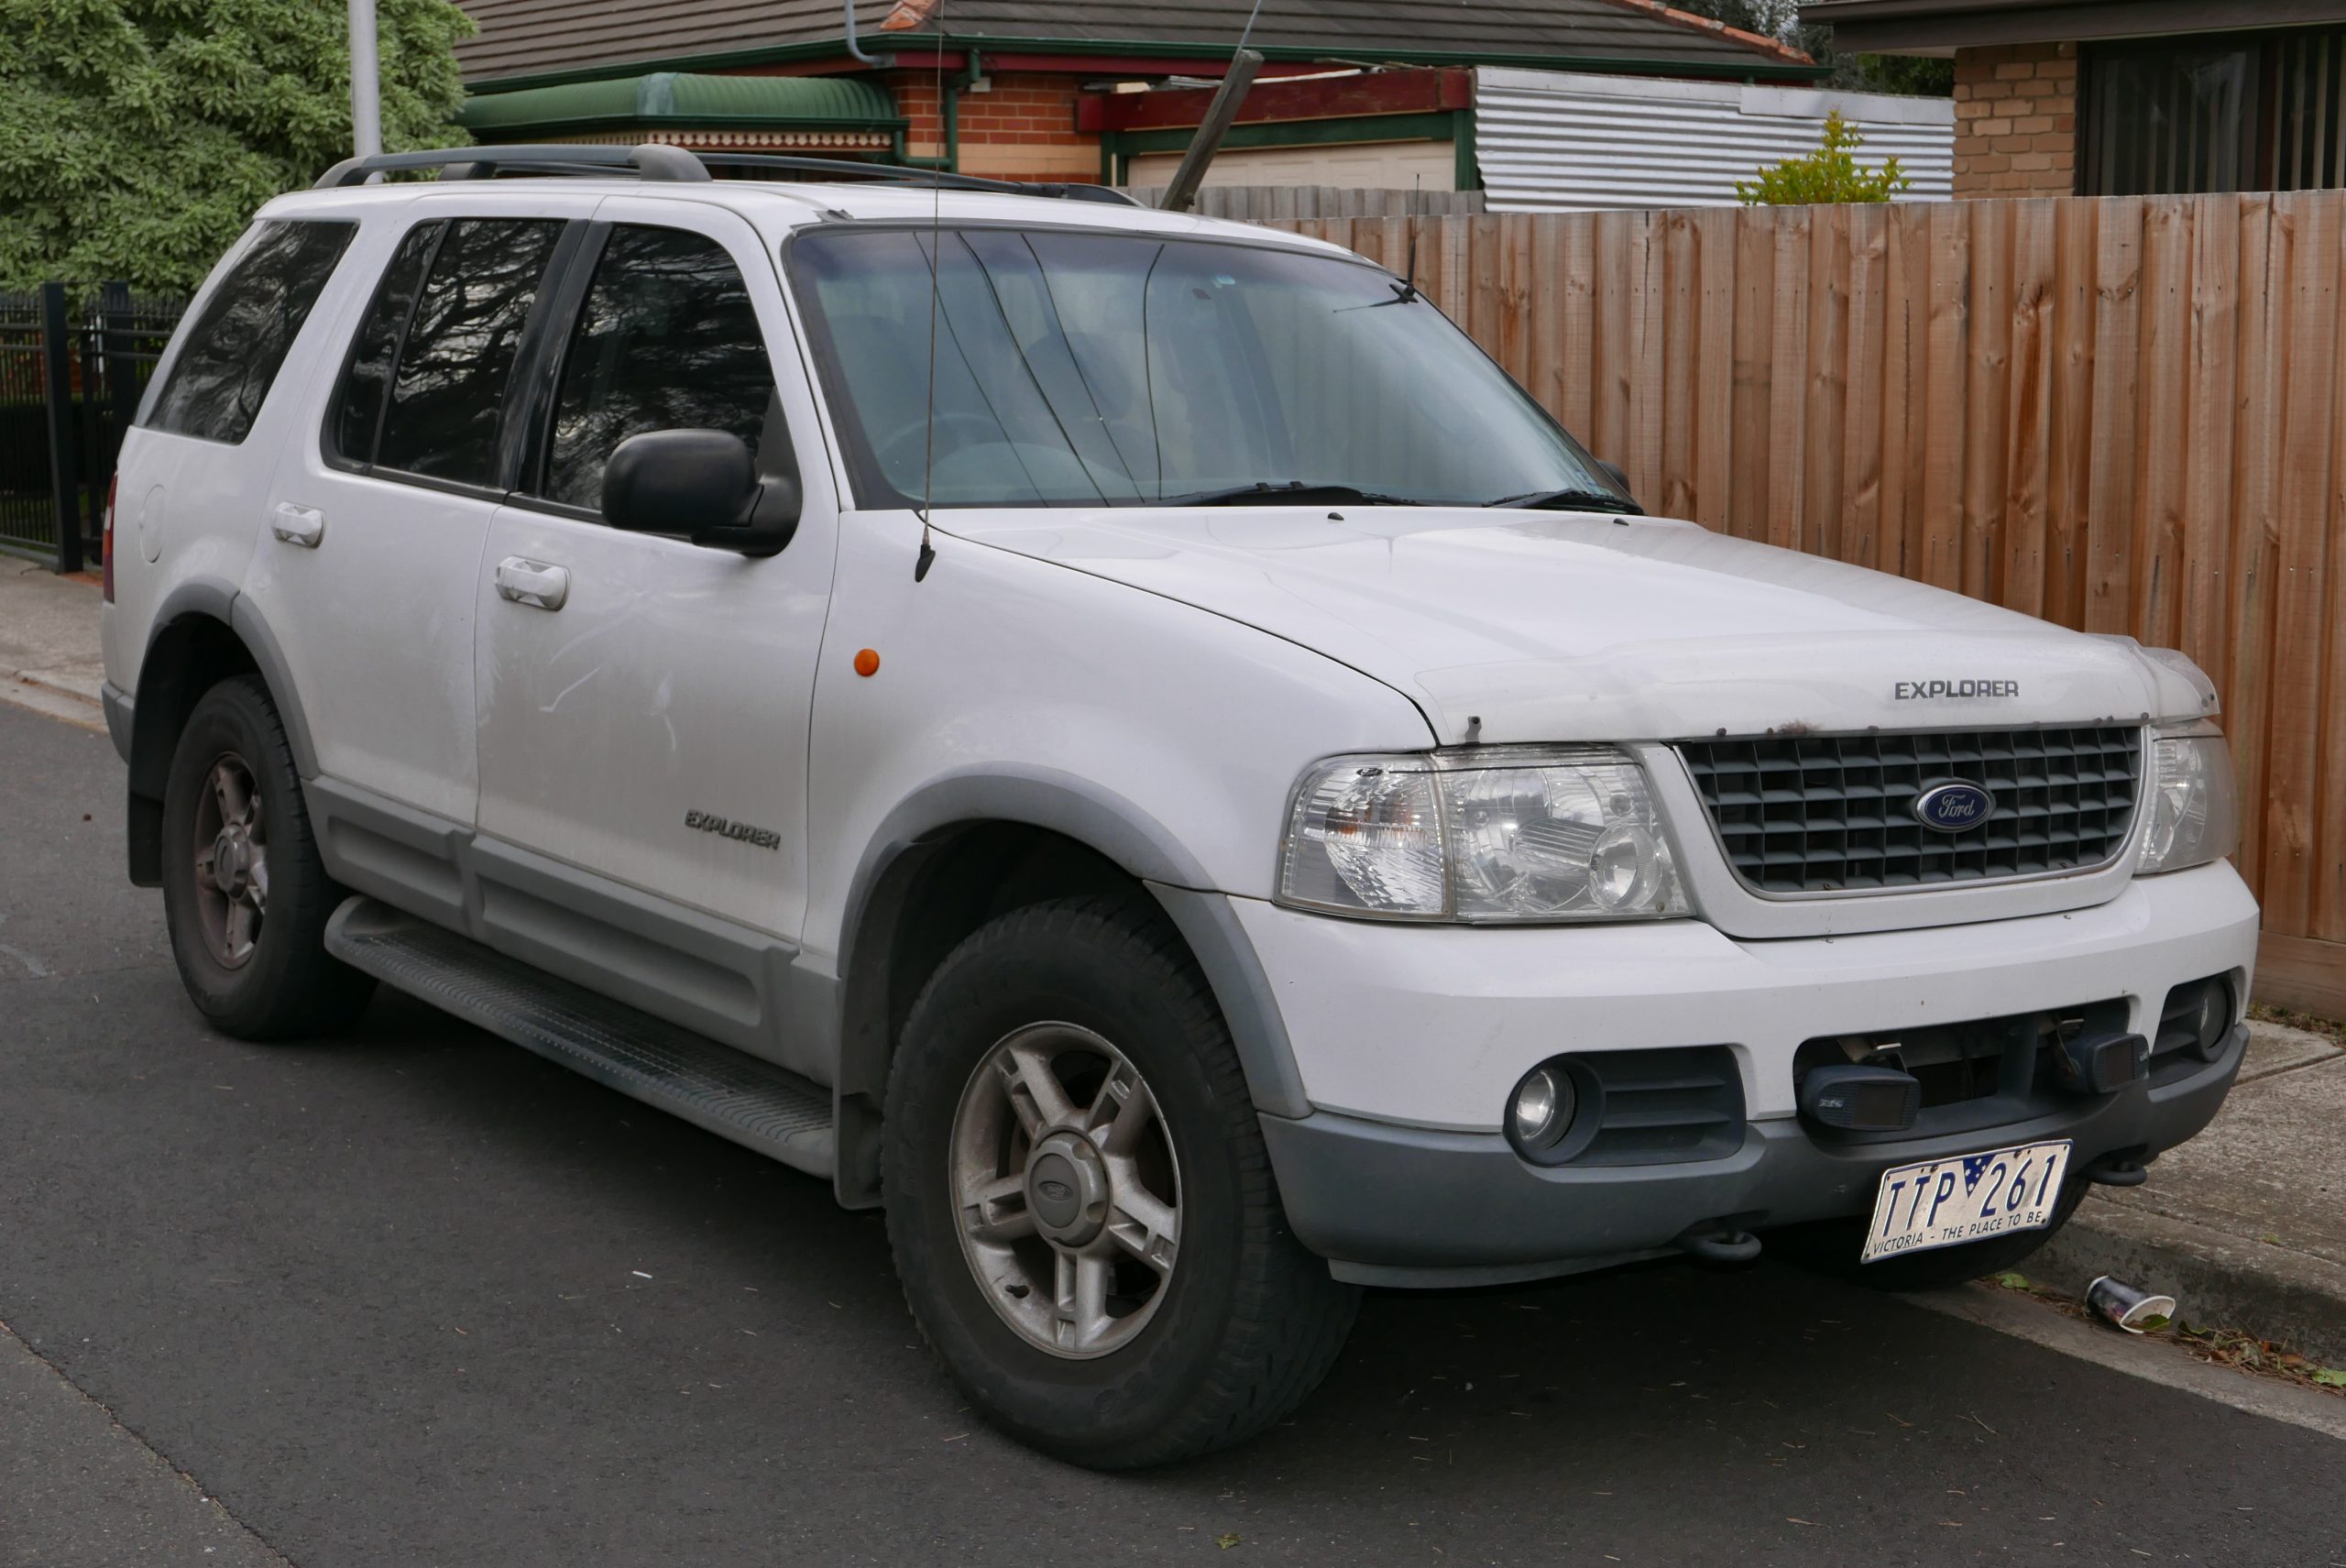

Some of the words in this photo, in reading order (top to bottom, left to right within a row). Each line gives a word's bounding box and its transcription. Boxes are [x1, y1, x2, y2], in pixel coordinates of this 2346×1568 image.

[1895, 680, 2019, 700] EXPLORER
[1938, 794, 1975, 818] Ford
[685, 809, 781, 850] EXPLORER
[1882, 1171, 1956, 1237] TTP
[1979, 1155, 2056, 1218] 261
[1873, 1232, 1923, 1254] VICTORIA
[1943, 1226, 1964, 1240] THE
[1969, 1219, 2002, 1236] PLACE
[2008, 1213, 2021, 1226] TO
[2027, 1211, 2042, 1223] BE
